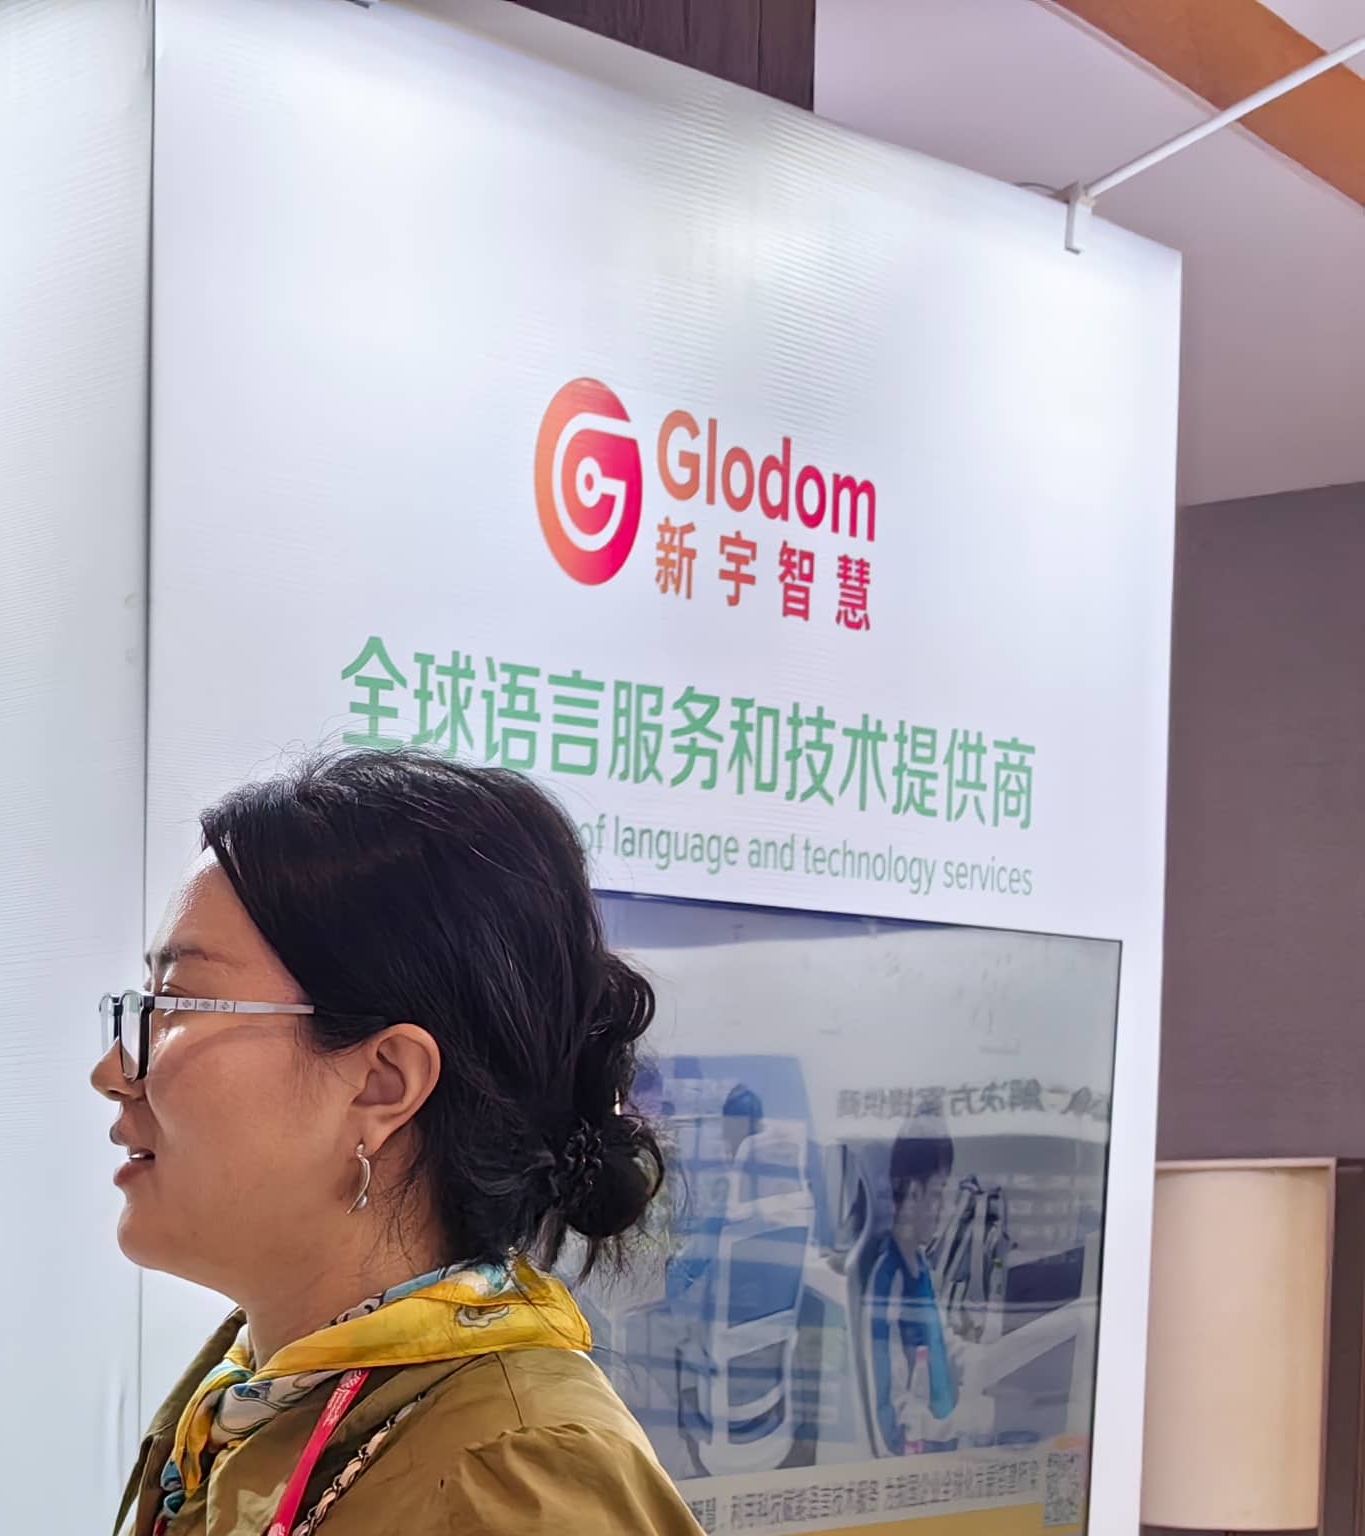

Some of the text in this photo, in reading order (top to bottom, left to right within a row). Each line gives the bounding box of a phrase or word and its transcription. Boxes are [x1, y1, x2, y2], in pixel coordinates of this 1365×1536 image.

[656, 409, 878, 541] Glodom
[653, 516, 871, 633] 新宇智慧
[340, 635, 1037, 831] 全球语言服务和技术提供商
[615, 817, 739, 875] language
[748, 834, 796, 873] and
[803, 839, 937, 896] technology
[943, 855, 1033, 897] services
